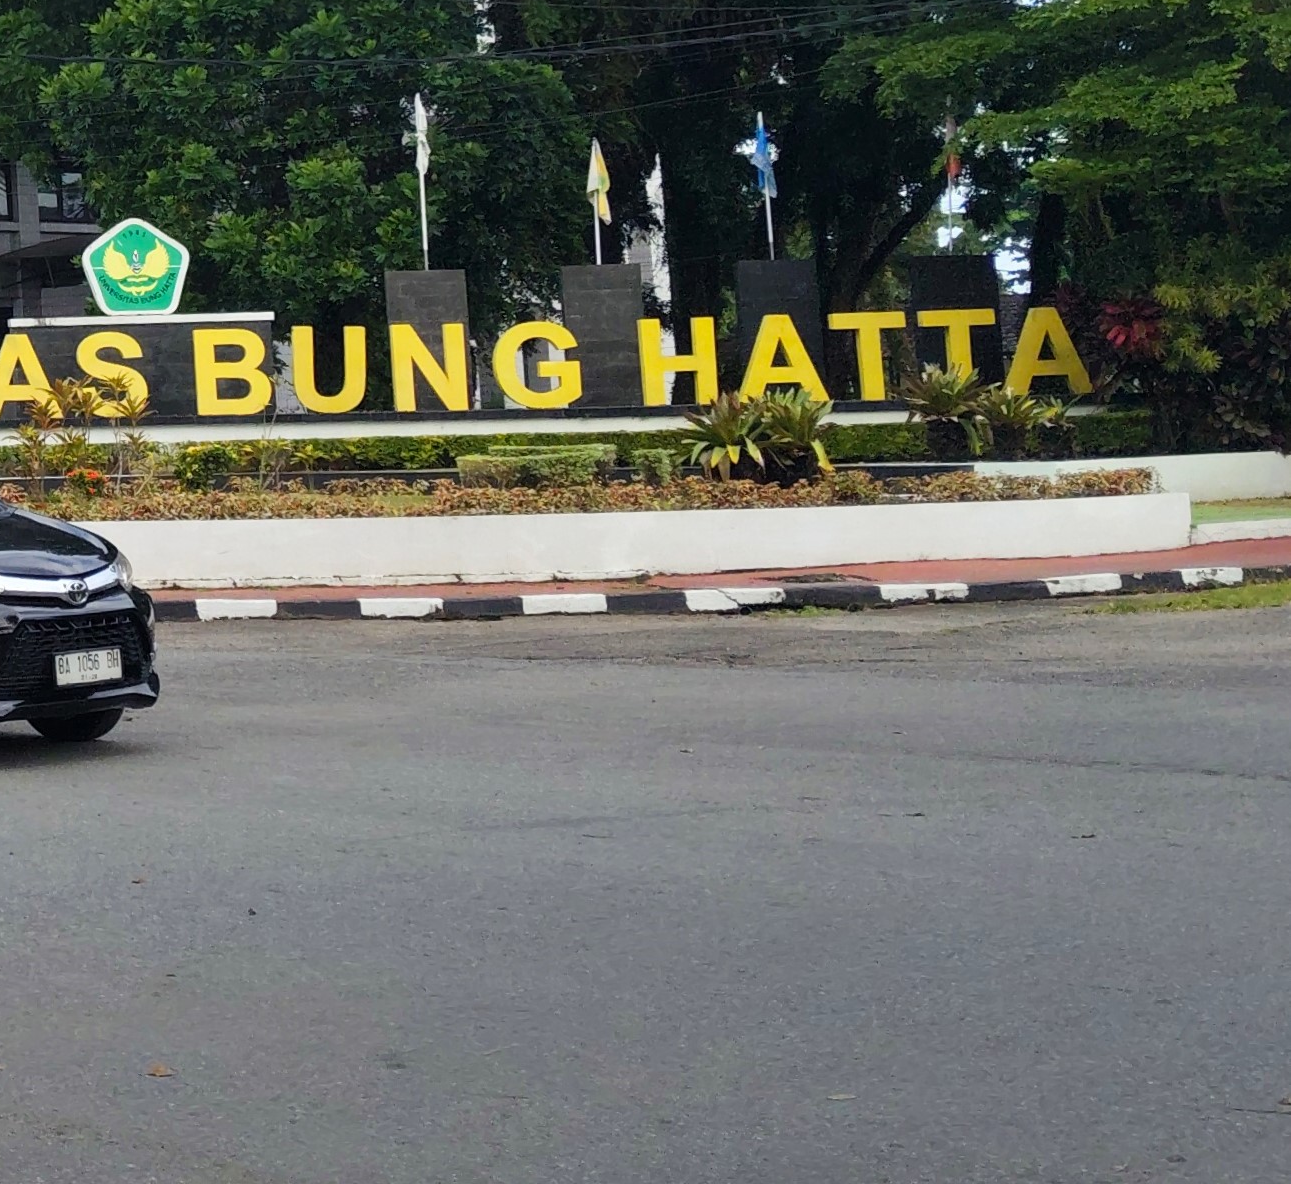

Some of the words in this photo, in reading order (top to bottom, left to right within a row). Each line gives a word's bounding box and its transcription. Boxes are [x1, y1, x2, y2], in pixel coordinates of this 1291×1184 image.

[98, 275, 139, 305] UNIVERSITAS
[141, 291, 163, 305] BUNG
[161, 272, 177, 295] HATTA
[192, 320, 583, 416] BUNG
[636, 307, 1094, 407] HATTA
[58, 657, 70, 674] BA
[77, 654, 100, 672] 1056
[107, 650, 119, 668] BH
